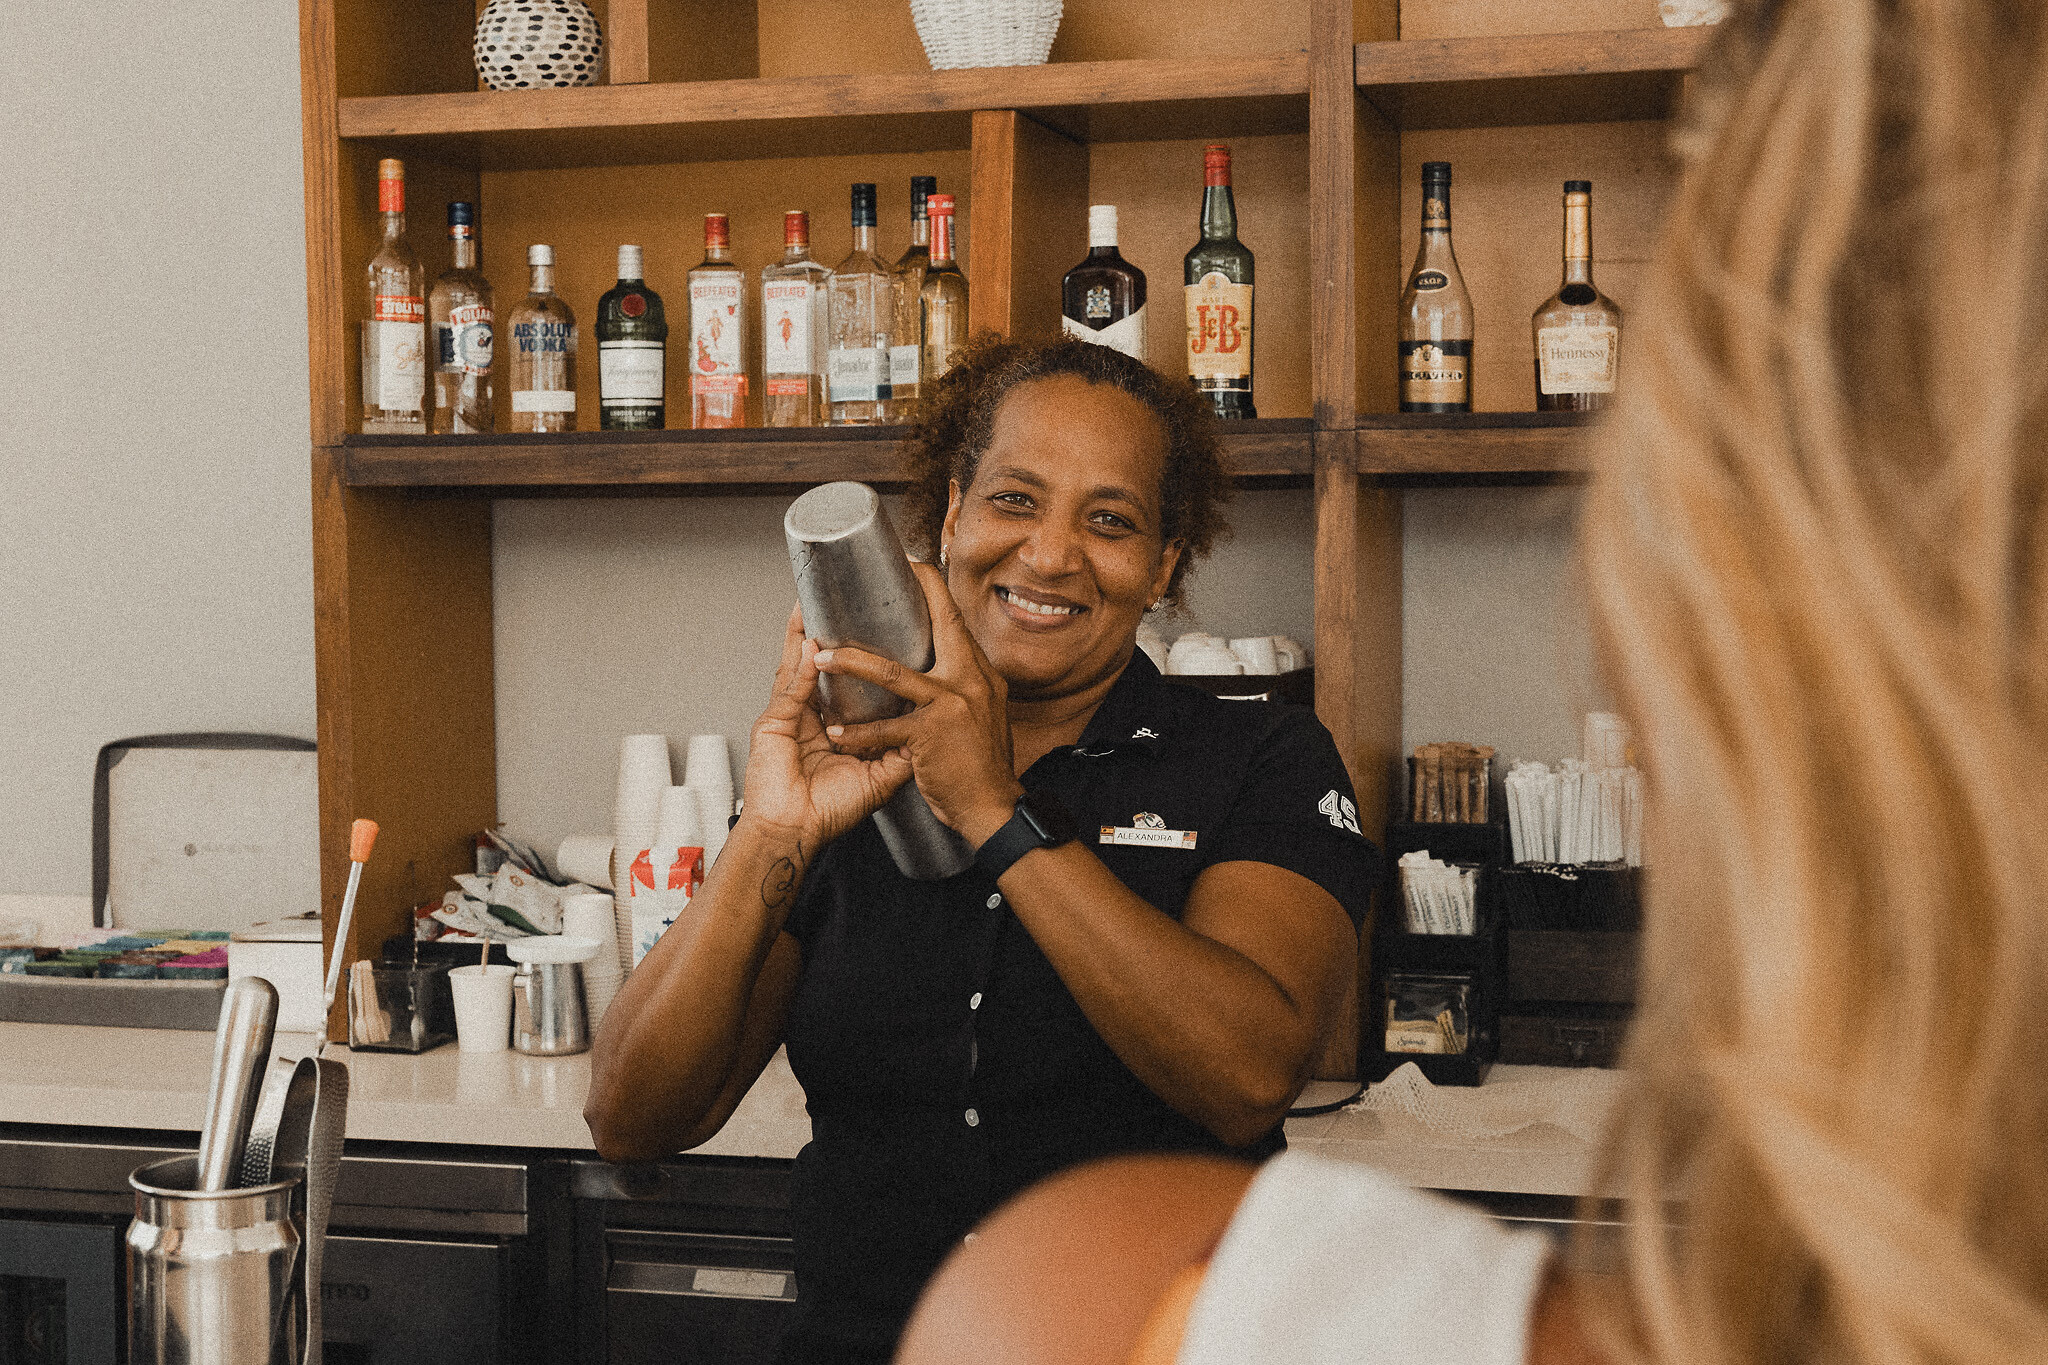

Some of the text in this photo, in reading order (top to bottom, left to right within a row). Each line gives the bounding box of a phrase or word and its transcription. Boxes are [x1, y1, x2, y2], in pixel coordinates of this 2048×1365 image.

[766, 286, 807, 300] BEEFEATER
[514, 323, 573, 338] ABSOLUT
[1191, 304, 1242, 354] J&B
[519, 338, 568, 353] VODKA
[1551, 347, 1606, 360] Hennessy
[1116, 832, 1173, 843] ALEXANDRA
